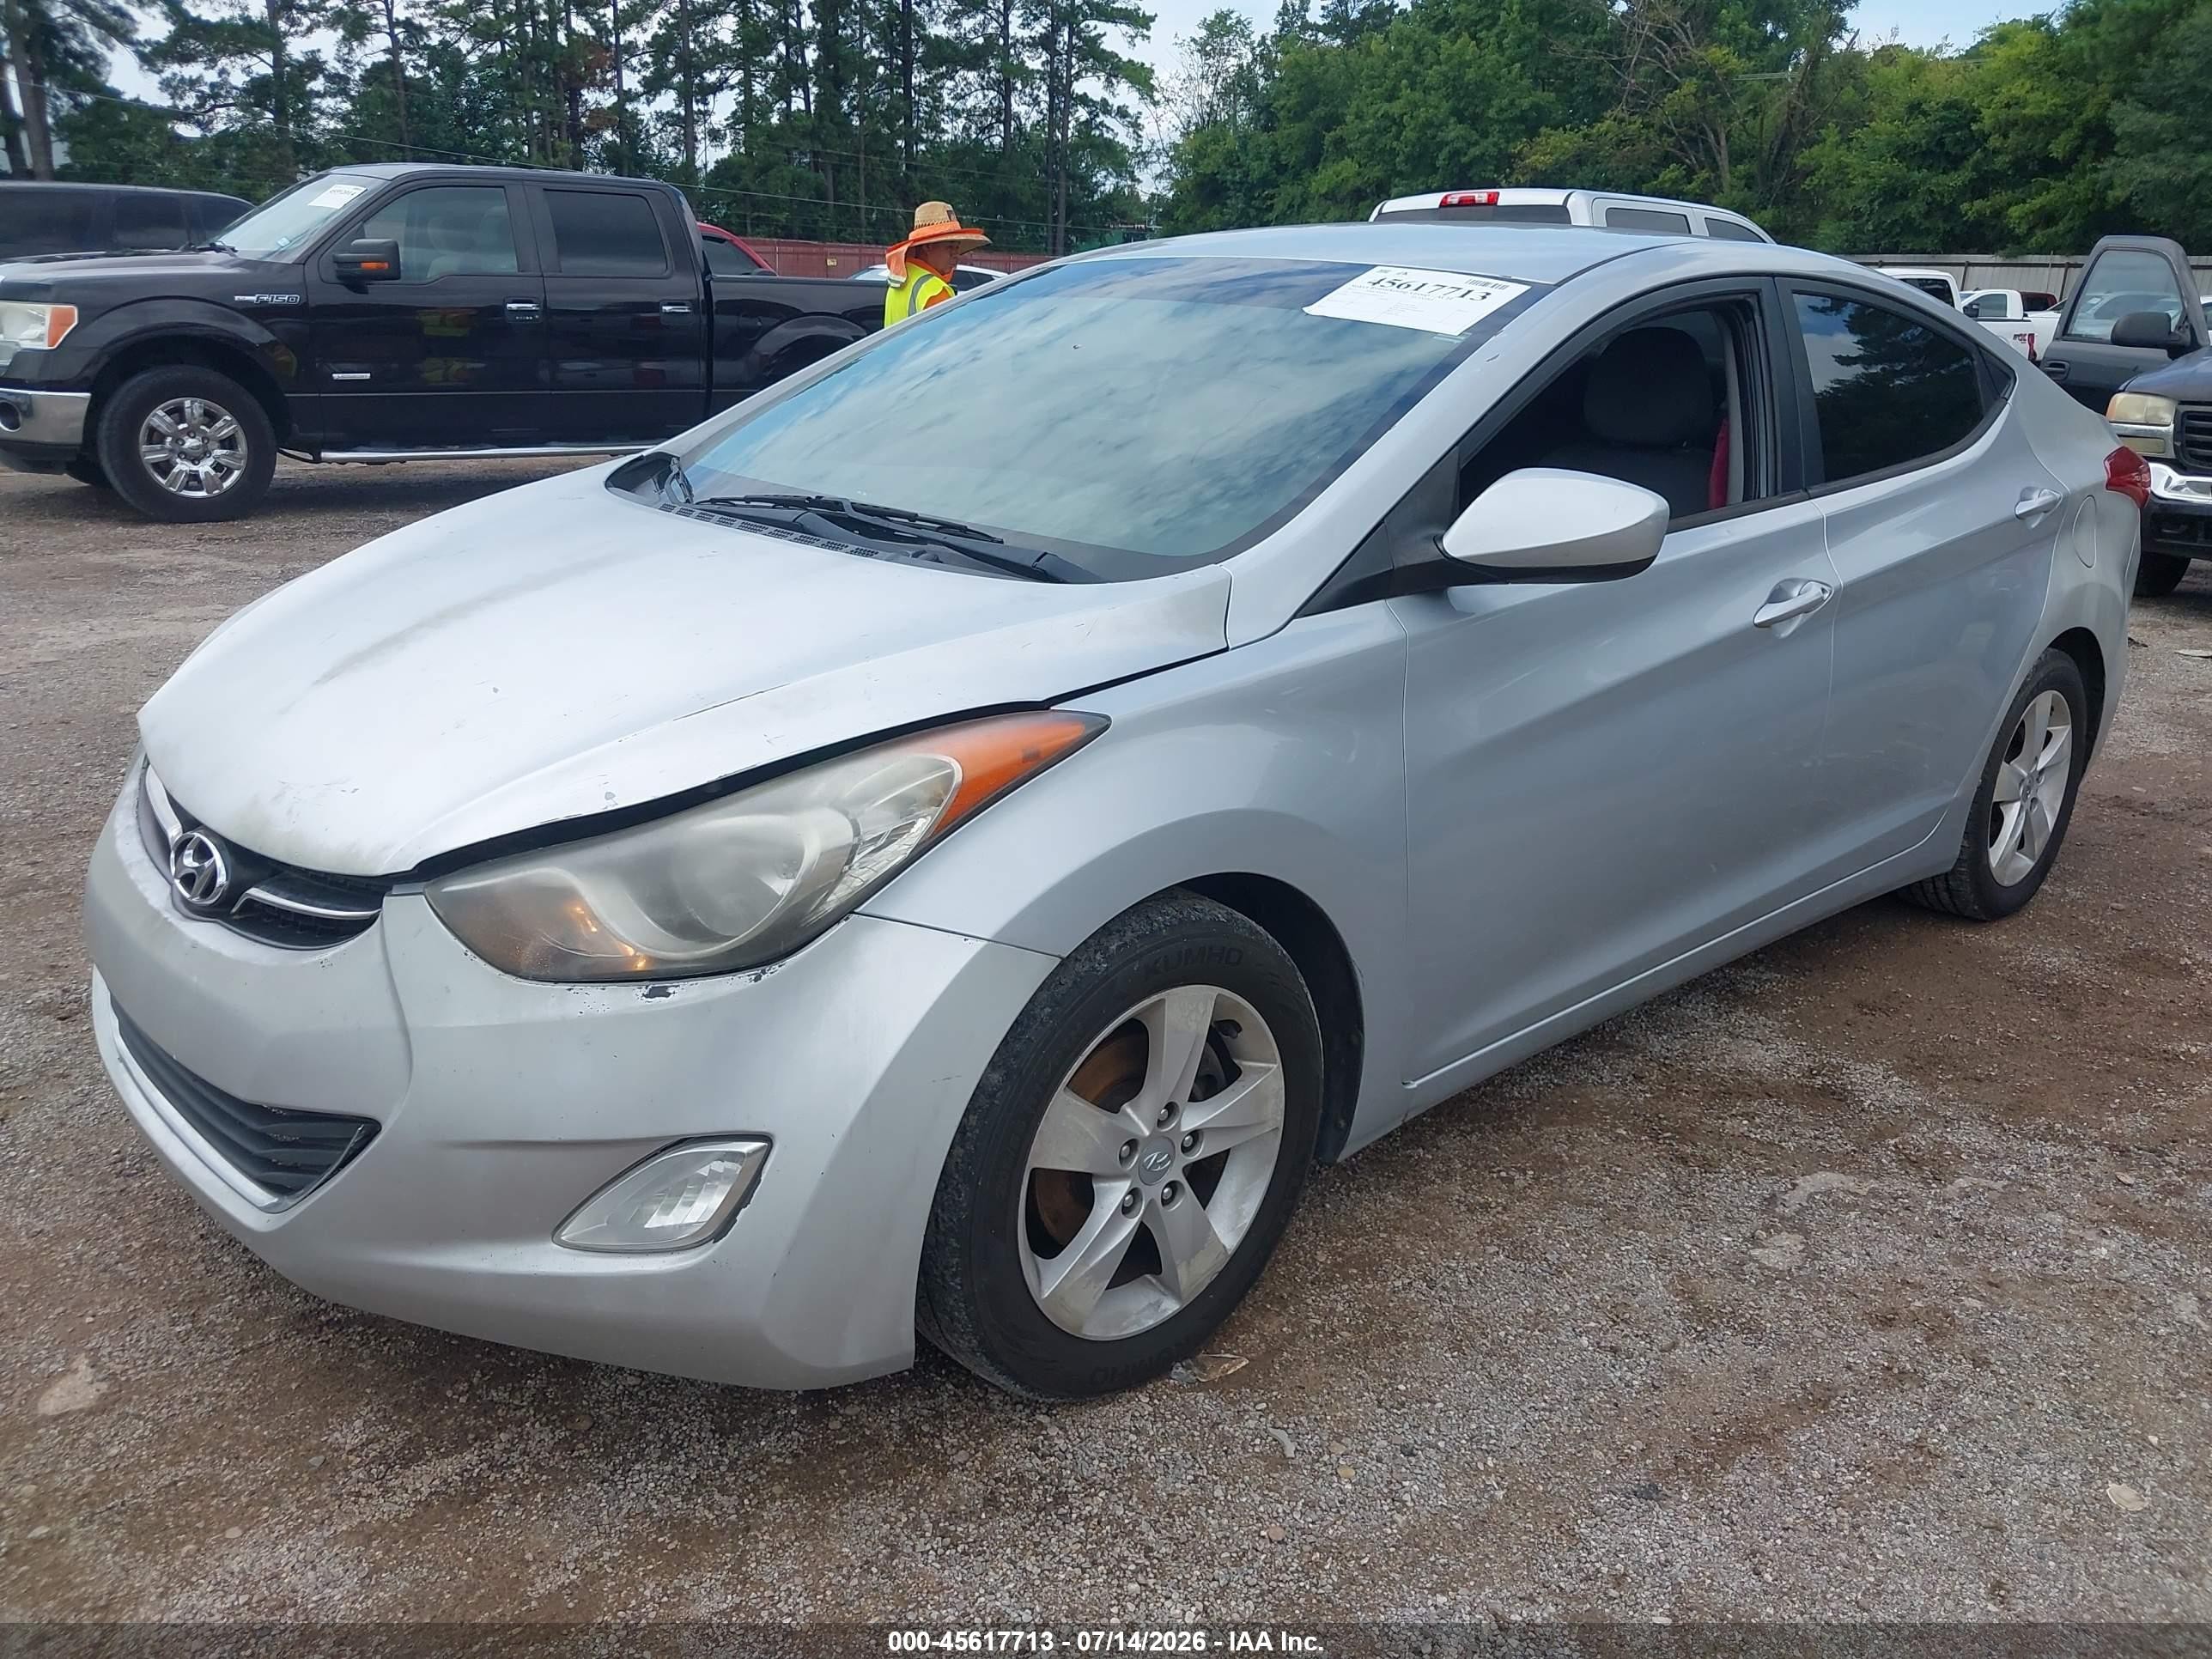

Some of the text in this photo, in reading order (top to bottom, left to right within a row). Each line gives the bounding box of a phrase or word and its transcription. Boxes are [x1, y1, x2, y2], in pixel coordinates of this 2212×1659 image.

[254, 294, 301, 305] F-150
[1367, 276, 1492, 301] 45617713
[1145, 945, 1244, 981] KUMHO
